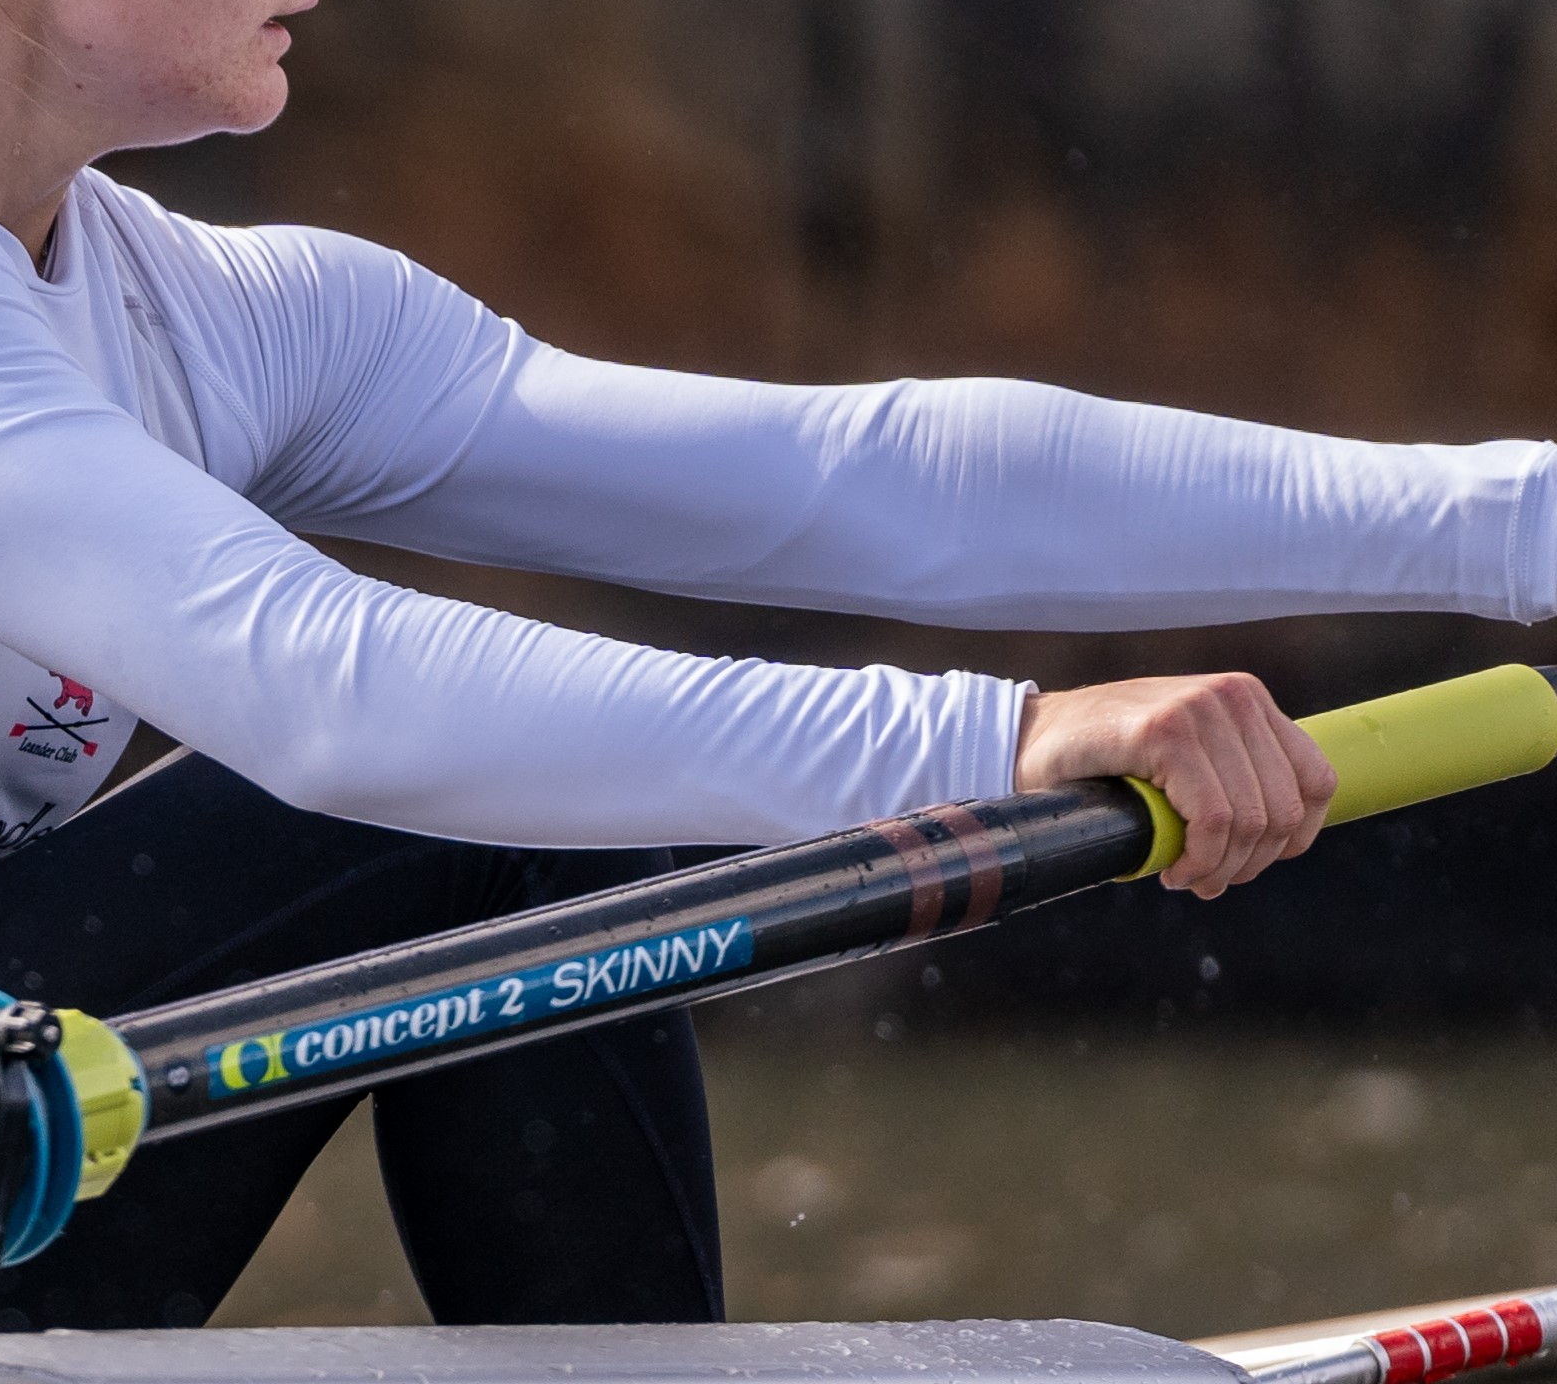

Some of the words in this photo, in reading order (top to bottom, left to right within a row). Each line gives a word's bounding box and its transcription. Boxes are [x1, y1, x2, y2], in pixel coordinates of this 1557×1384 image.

[18, 736, 56, 759] Leander
[54, 746, 79, 764] Club
[294, 987, 486, 1068] concept
[497, 977, 525, 1017] 2
[549, 921, 743, 1008] SKINNY
